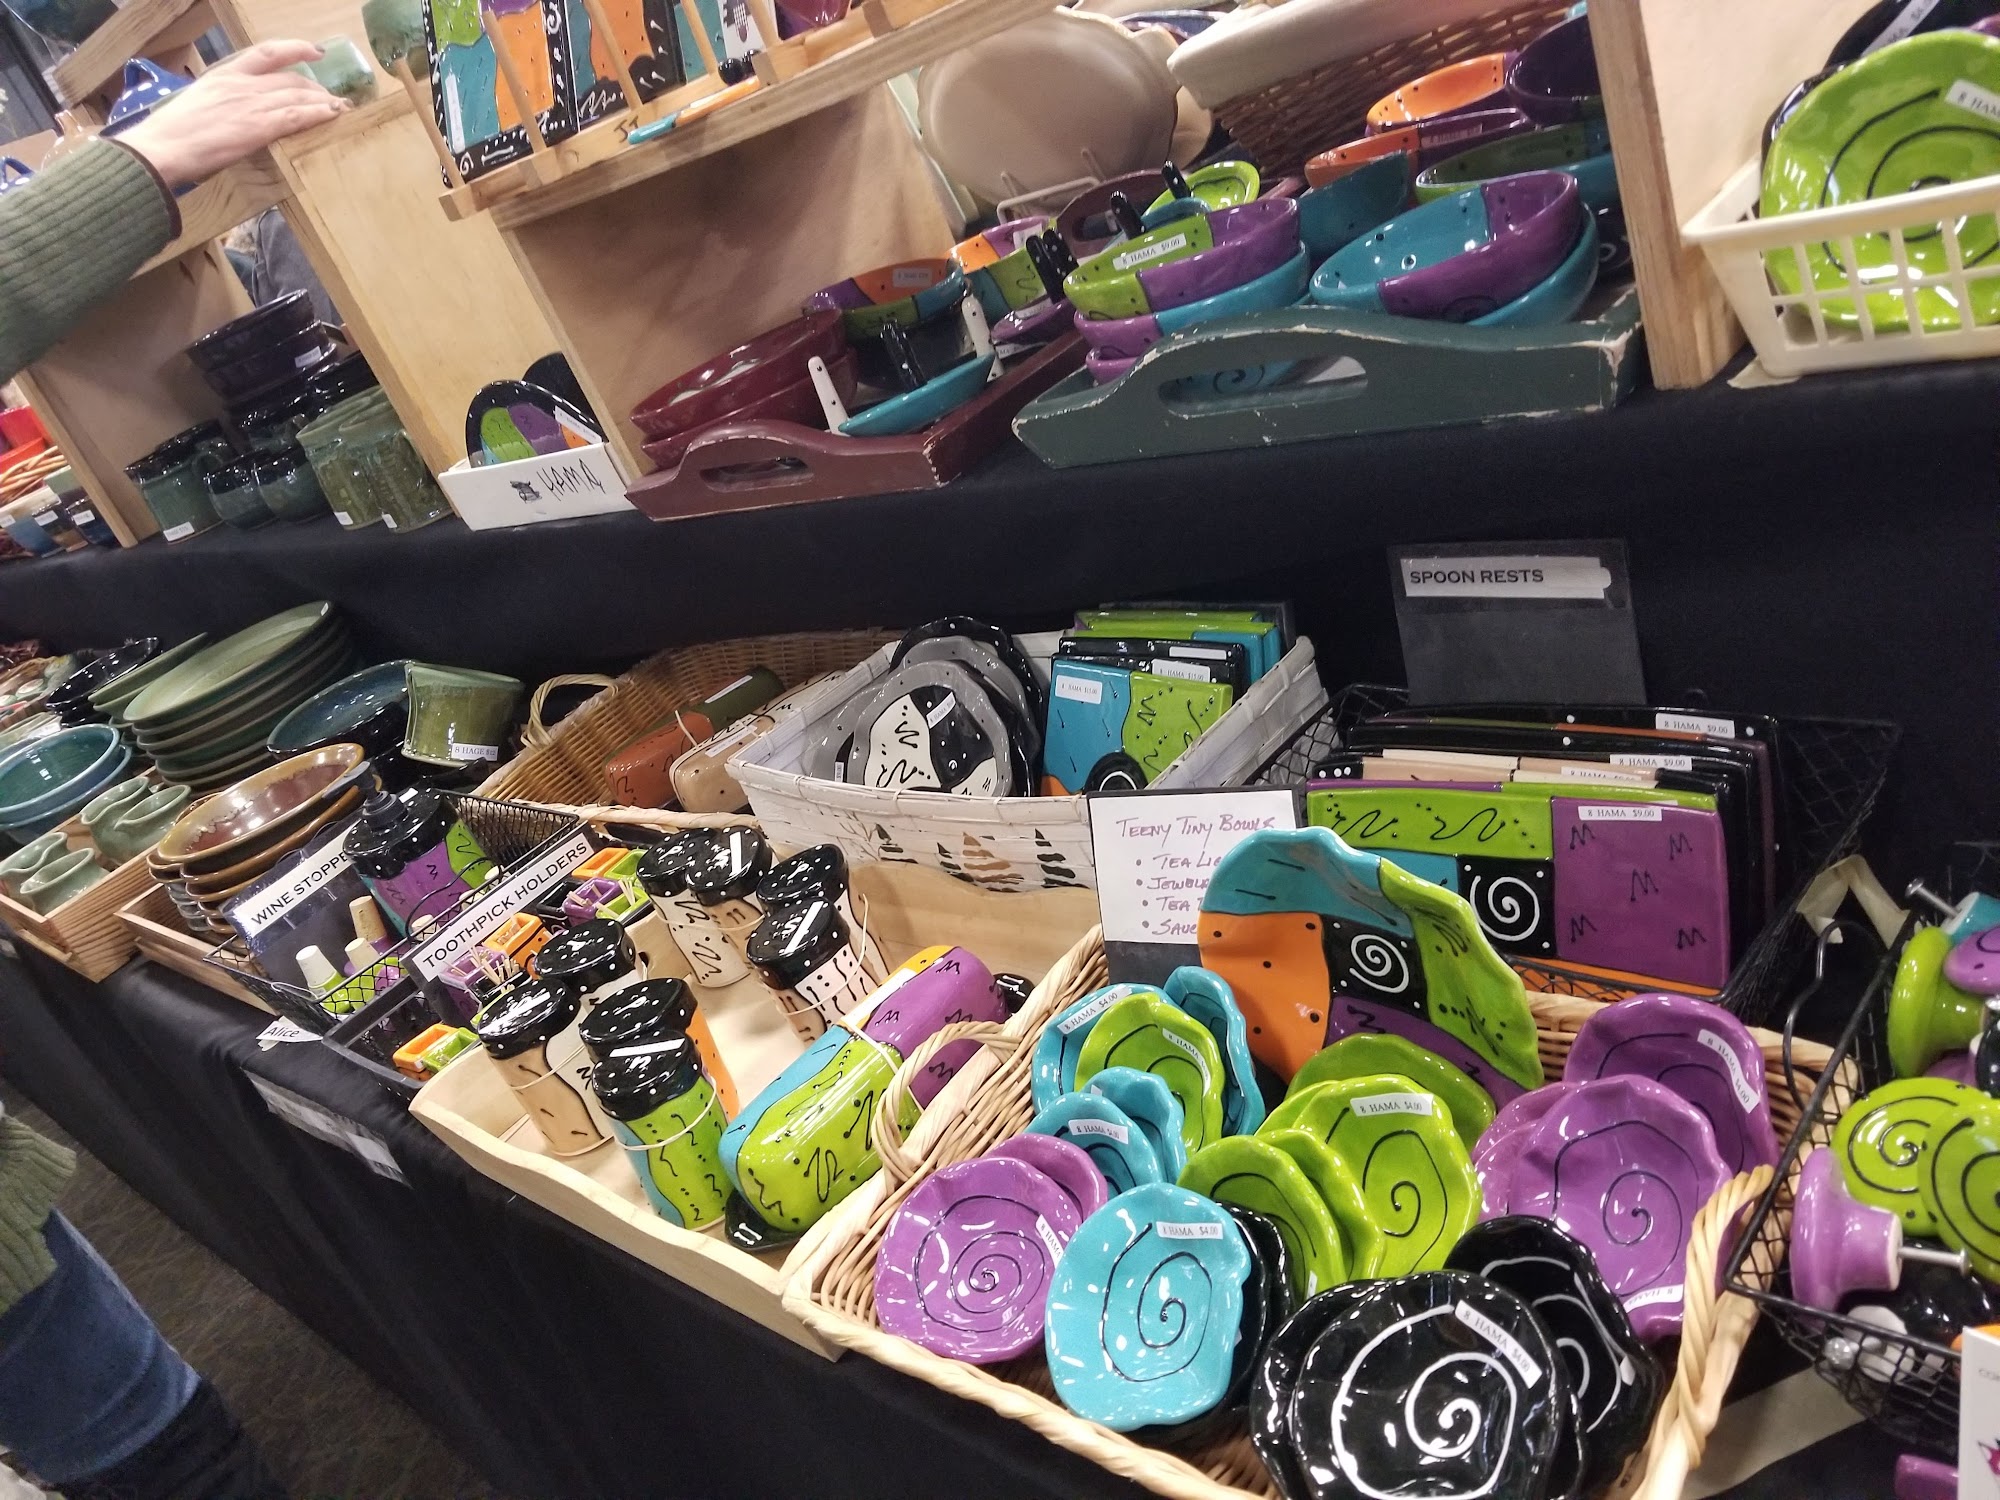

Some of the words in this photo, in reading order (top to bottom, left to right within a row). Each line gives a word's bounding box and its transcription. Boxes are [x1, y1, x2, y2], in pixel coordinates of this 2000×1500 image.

[1131, 248, 1156, 262] HAMA
[1161, 239, 1180, 251] $9.00
[1410, 569, 1475, 584] SPOON
[1481, 568, 1544, 583] RESTS
[1673, 721, 1702, 731] HAMA
[1707, 724, 1728, 734] $9.00
[462, 747, 484, 756] HAGE
[1629, 758, 1658, 767] HAMA
[1664, 759, 1685, 767] $9.00
[1597, 809, 1626, 817] HAMA
[1632, 809, 1655, 817] $9.00
[1152, 854, 1191, 869] TEA
[251, 890, 294, 926] WINE
[293, 851, 348, 898] STOPPE
[423, 894, 515, 968] TOOTHPICK
[514, 841, 589, 901] HOLDERS
[1155, 896, 1191, 911] TEA
[1071, 1008, 1097, 1026] HAMA
[1098, 992, 1118, 1008] $4.00
[266, 1026, 300, 1038] Alice
[1176, 1039, 1199, 1059] HAMA
[1717, 1045, 1737, 1073] HAMA
[1735, 1079, 1750, 1105] $4.00
[1359, 1105, 1366, 1113] 8
[1369, 1102, 1400, 1113] HAMA
[1404, 1102, 1422, 1112] $4.00
[1083, 1125, 1105, 1133] HAMA
[1168, 1225, 1194, 1236] HAMA
[1199, 1226, 1218, 1236] $4.00
[1045, 1231, 1061, 1258] HAMA
[1464, 1310, 1470, 1320] 8
[1474, 1319, 1508, 1350] HAMA
[1511, 1348, 1531, 1374] $4.00
